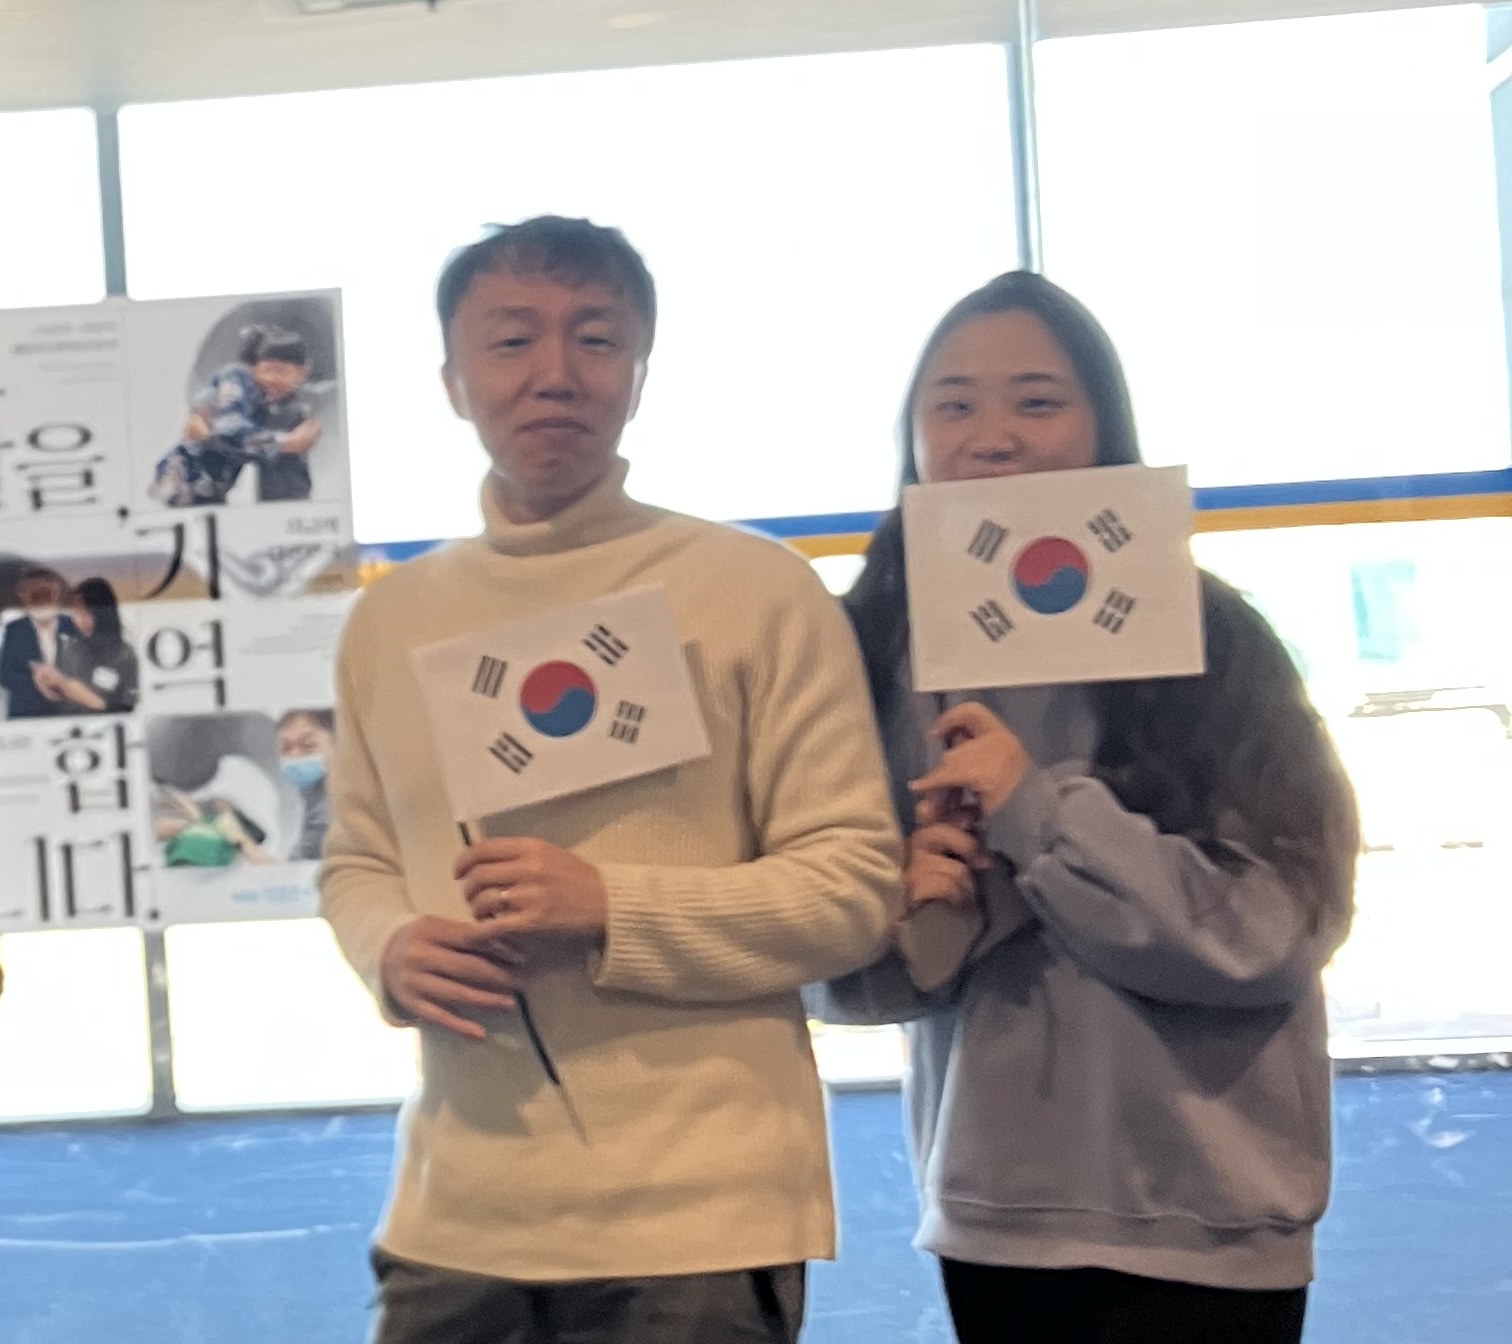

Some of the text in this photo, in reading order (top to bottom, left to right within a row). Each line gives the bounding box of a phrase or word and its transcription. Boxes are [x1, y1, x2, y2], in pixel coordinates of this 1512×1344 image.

[134, 511, 221, 600] 기
[147, 619, 226, 707] 억
[49, 722, 146, 814] 합
